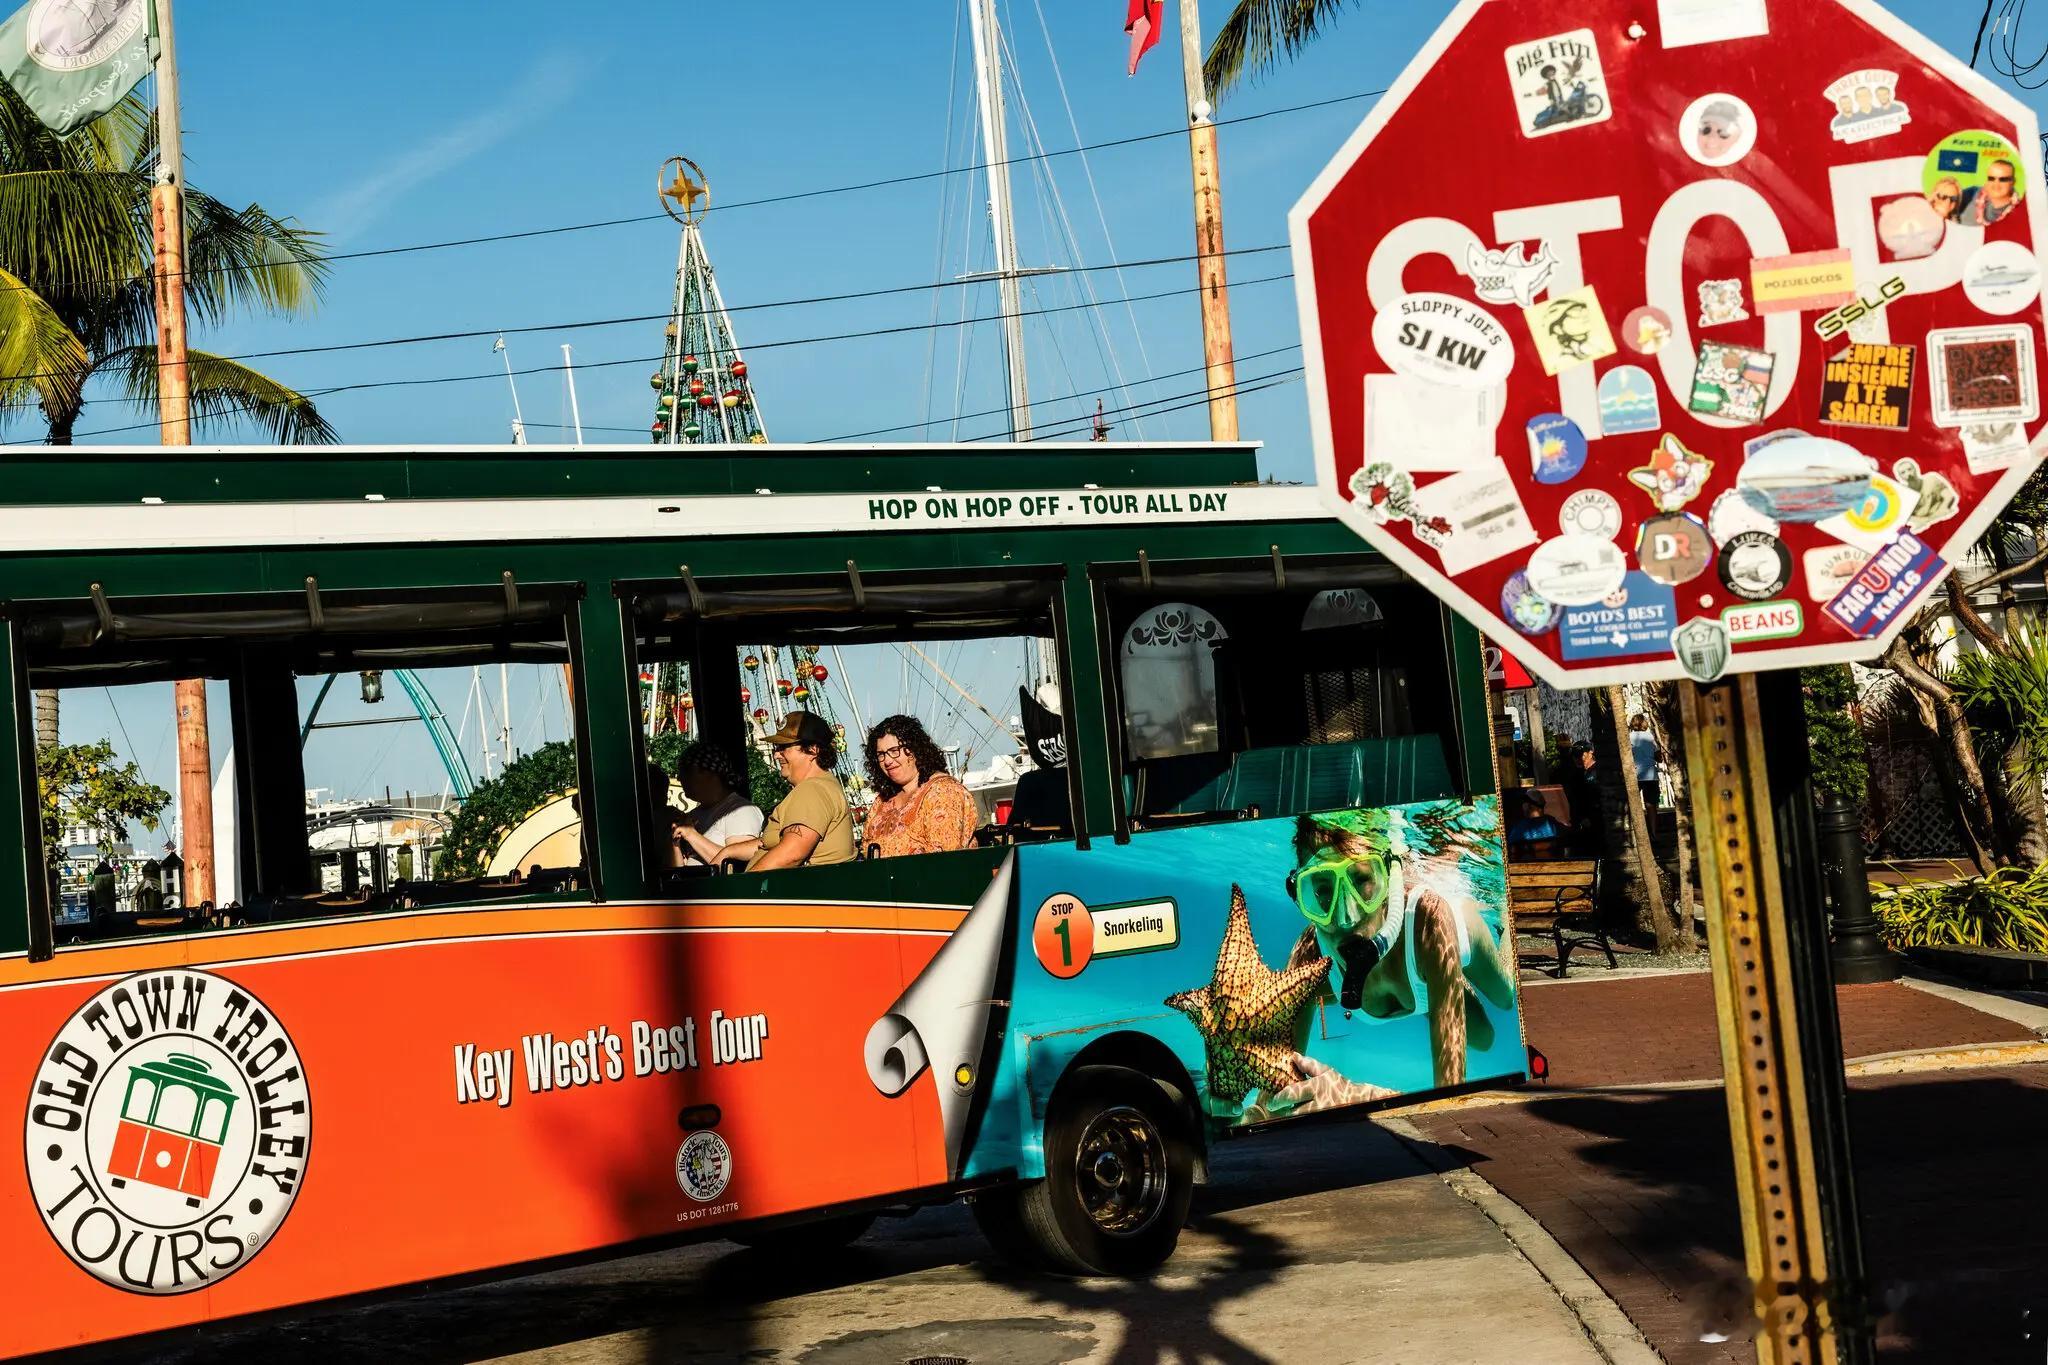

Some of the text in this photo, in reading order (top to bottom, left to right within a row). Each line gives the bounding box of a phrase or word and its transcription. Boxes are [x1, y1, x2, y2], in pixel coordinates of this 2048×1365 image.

[1516, 45, 1545, 77] Big
[1401, 300, 1502, 346] SLOPPY JOE'S
[1398, 322, 1433, 351] SJ
[1436, 336, 1488, 371] KW
[1846, 344, 1912, 367] EMPRE
[1826, 362, 1910, 388] INSIEME
[1844, 383, 1887, 406] A TE
[1829, 401, 1900, 427] SAREM
[868, 498, 918, 520] HOP
[925, 497, 959, 519] ON
[966, 497, 1012, 518] HOP
[1019, 495, 1060, 517] OFF
[1079, 494, 1139, 515] TOUR
[1145, 493, 1183, 513] ALL
[1188, 492, 1229, 512] DAY
[1833, 533, 1922, 624] FACUNDO
[1567, 604, 1666, 626] BOYD'S BEST
[1729, 609, 1795, 632] BEANS
[1051, 902, 1074, 916] STOP
[1104, 916, 1163, 937] Snorkeling
[1053, 918, 1072, 967] 1
[454, 1009, 768, 1107] Key West's Best Tour
[32, 975, 306, 1195] OLD TOWN TROLLEY
[678, 1134, 728, 1172] Historic Tours
[677, 1202, 739, 1222] US DOT 1281776
[46, 1164, 246, 1289] TOURS
